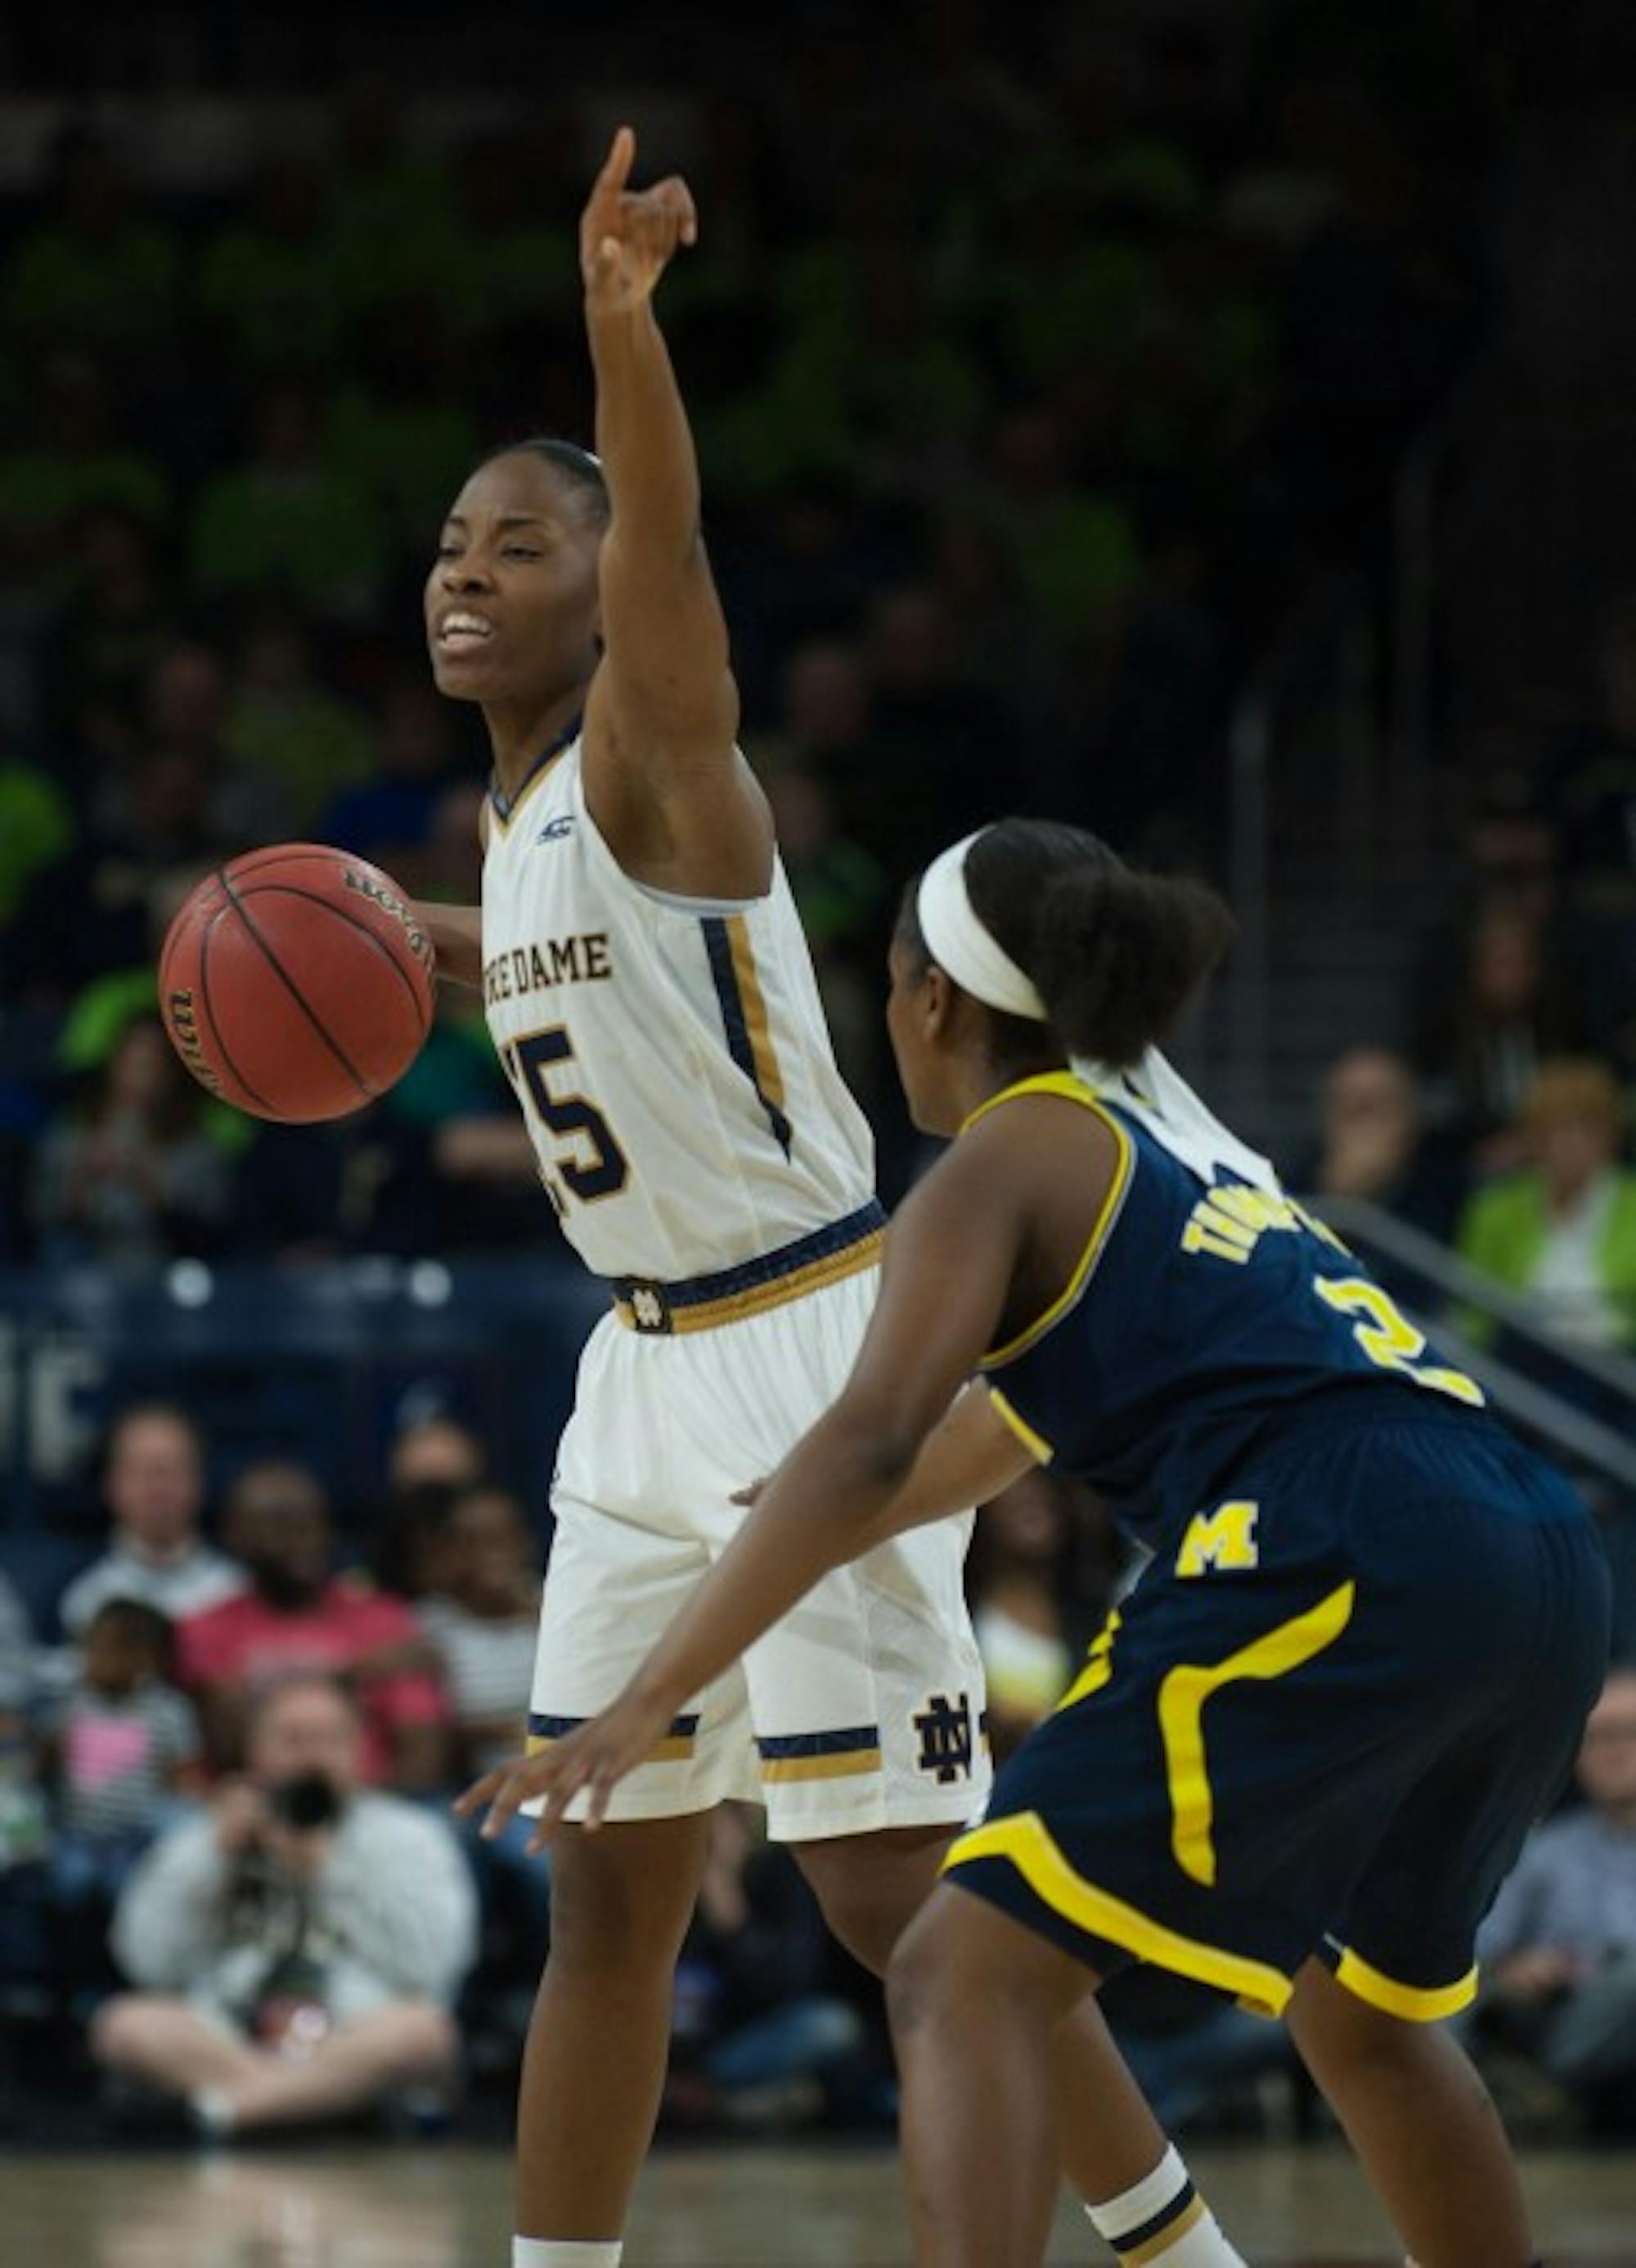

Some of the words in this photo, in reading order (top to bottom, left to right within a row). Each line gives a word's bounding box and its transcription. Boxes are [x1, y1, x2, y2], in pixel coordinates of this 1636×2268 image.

[512, 931, 613, 996] DAME
[501, 1024, 631, 1221] 5
[1314, 1274, 1485, 1408] 2
[1175, 1501, 1260, 1579] M
